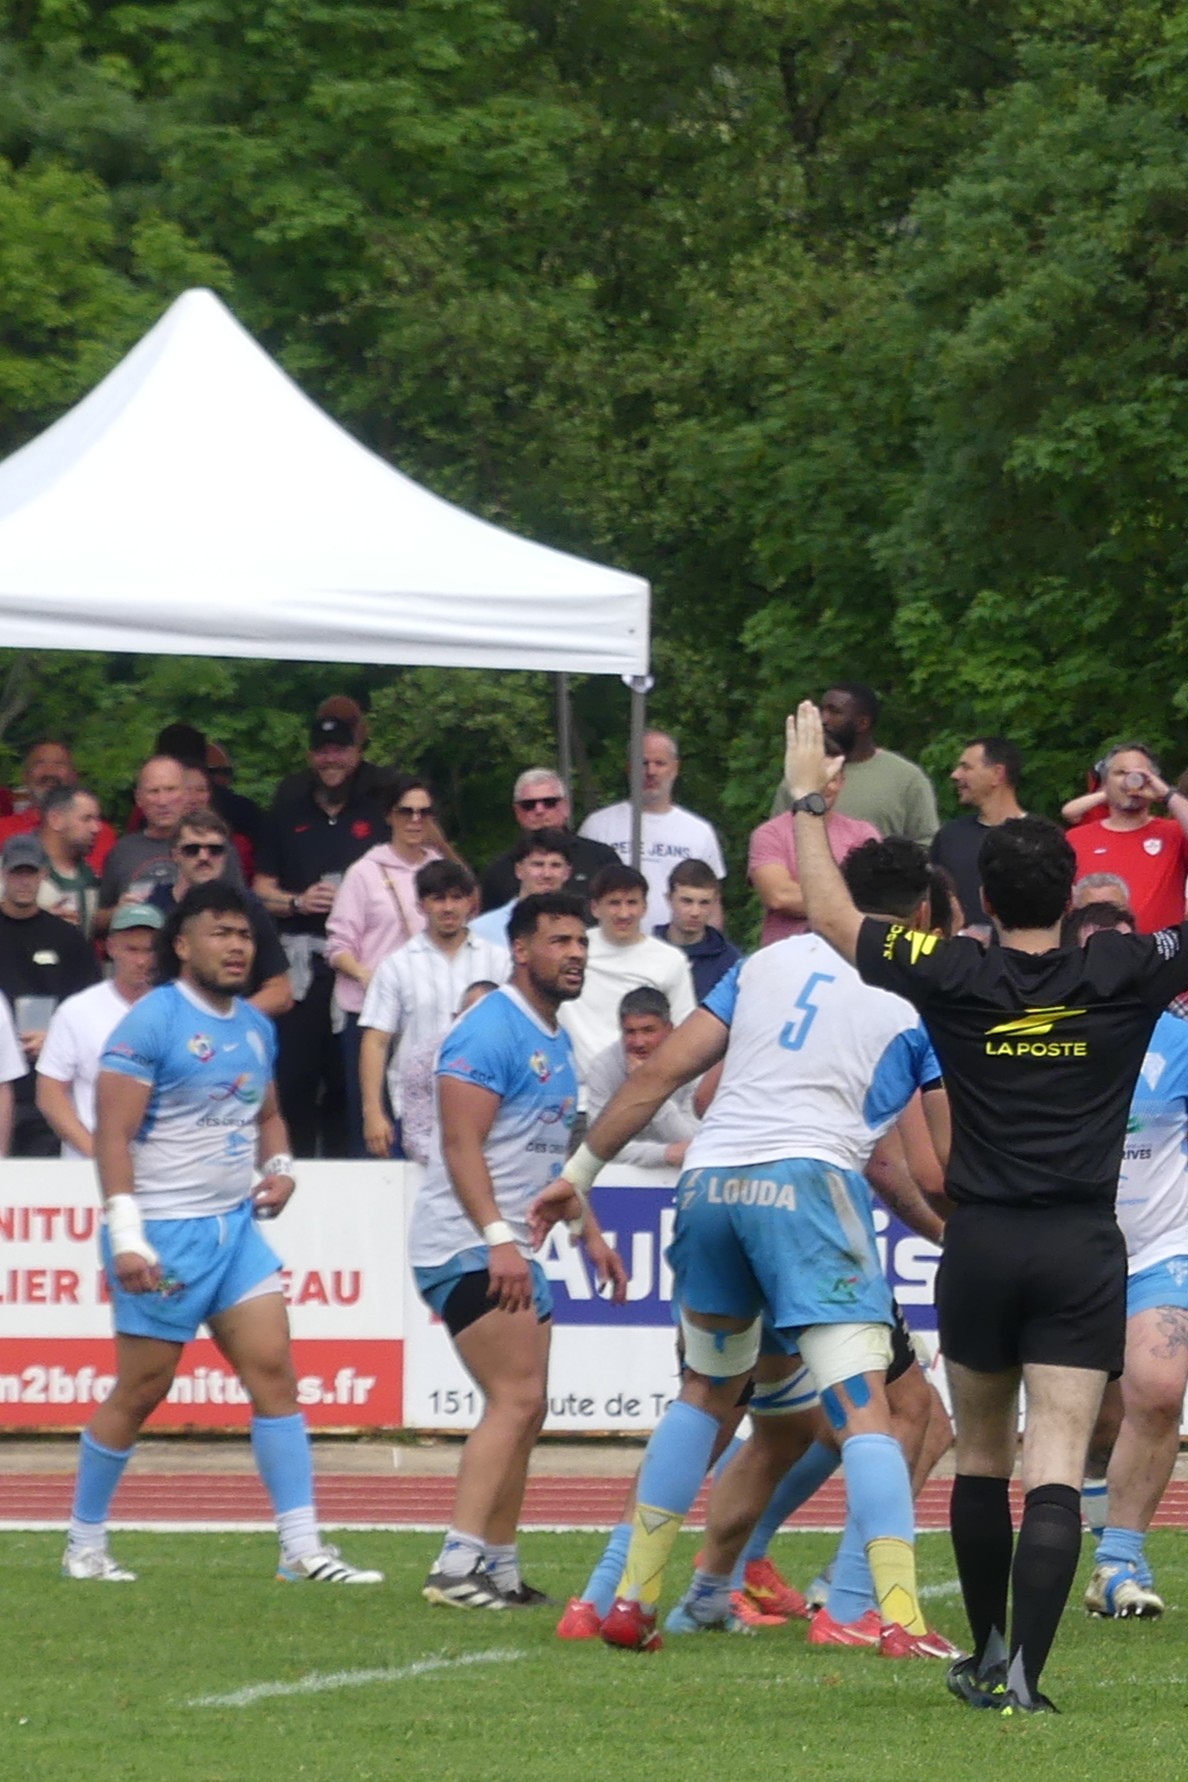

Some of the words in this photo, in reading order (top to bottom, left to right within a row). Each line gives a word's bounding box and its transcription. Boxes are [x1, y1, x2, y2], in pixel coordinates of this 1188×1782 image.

[647, 843, 691, 860] JEANS
[777, 971, 837, 1052] 5
[985, 1041, 1014, 1056] LA
[1016, 1041, 1088, 1057] POSTE
[707, 1176, 797, 1212] LOUDA
[604, 1393, 646, 1417] de
